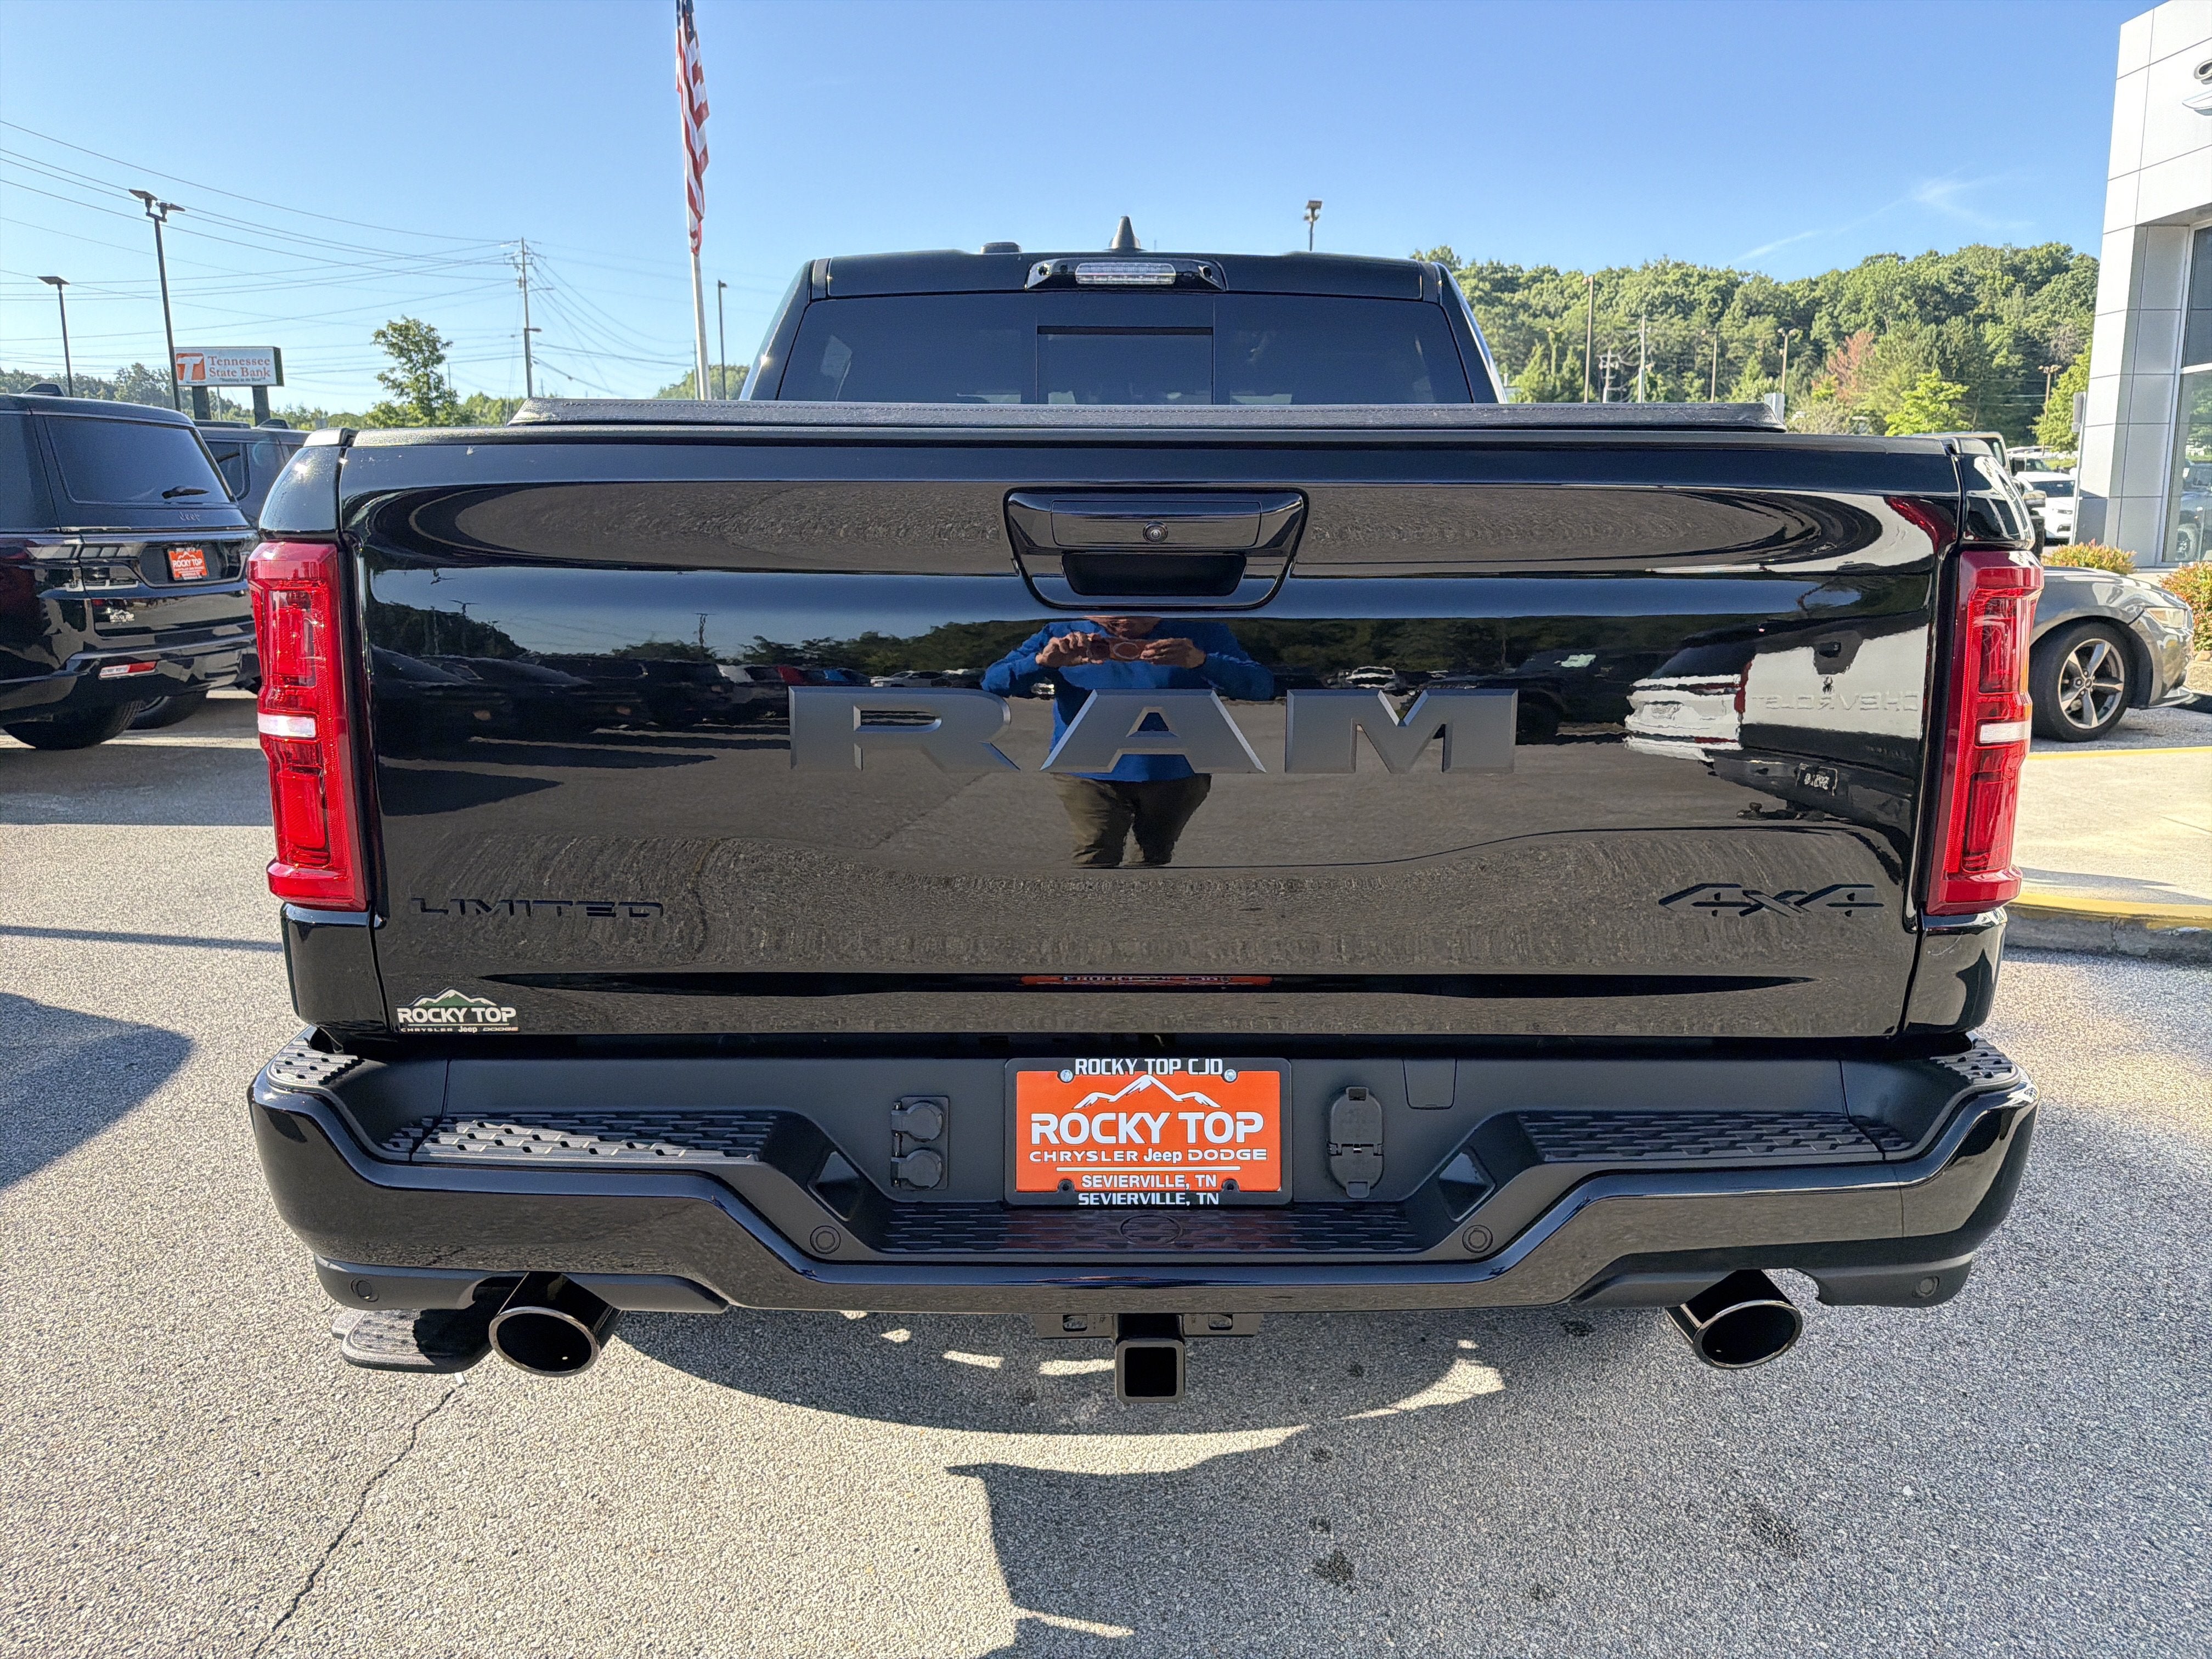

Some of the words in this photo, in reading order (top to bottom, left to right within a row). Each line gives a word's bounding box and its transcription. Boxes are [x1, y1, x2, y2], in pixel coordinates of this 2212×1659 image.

[207, 356, 270, 366] Tennessee
[209, 367, 237, 377] State
[241, 367, 271, 377] Bank
[173, 560, 191, 568] ROCKY
[191, 558, 202, 566] TOP
[789, 685, 1518, 774] RAM
[411, 896, 664, 918] LIMITED
[397, 1007, 468, 1023] ROCKY
[471, 1007, 517, 1023] TOP
[1075, 1058, 1138, 1075] ROCKY
[1144, 1058, 1181, 1075] TOP
[1188, 1058, 1223, 1075] CJD
[1030, 1111, 1172, 1146] ROCKY
[1178, 1111, 1265, 1144] TOP
[1029, 1150, 1138, 1162] CHRYSLER
[1143, 1148, 1182, 1164] Jeep
[1188, 1149, 1267, 1161] DODGE
[1081, 1175, 1190, 1190] SEVIERVILLE,
[1195, 1174, 1217, 1188] TN
[1078, 1193, 1190, 1206] SEVIERVILLE,
[1197, 1192, 1219, 1205] TN
